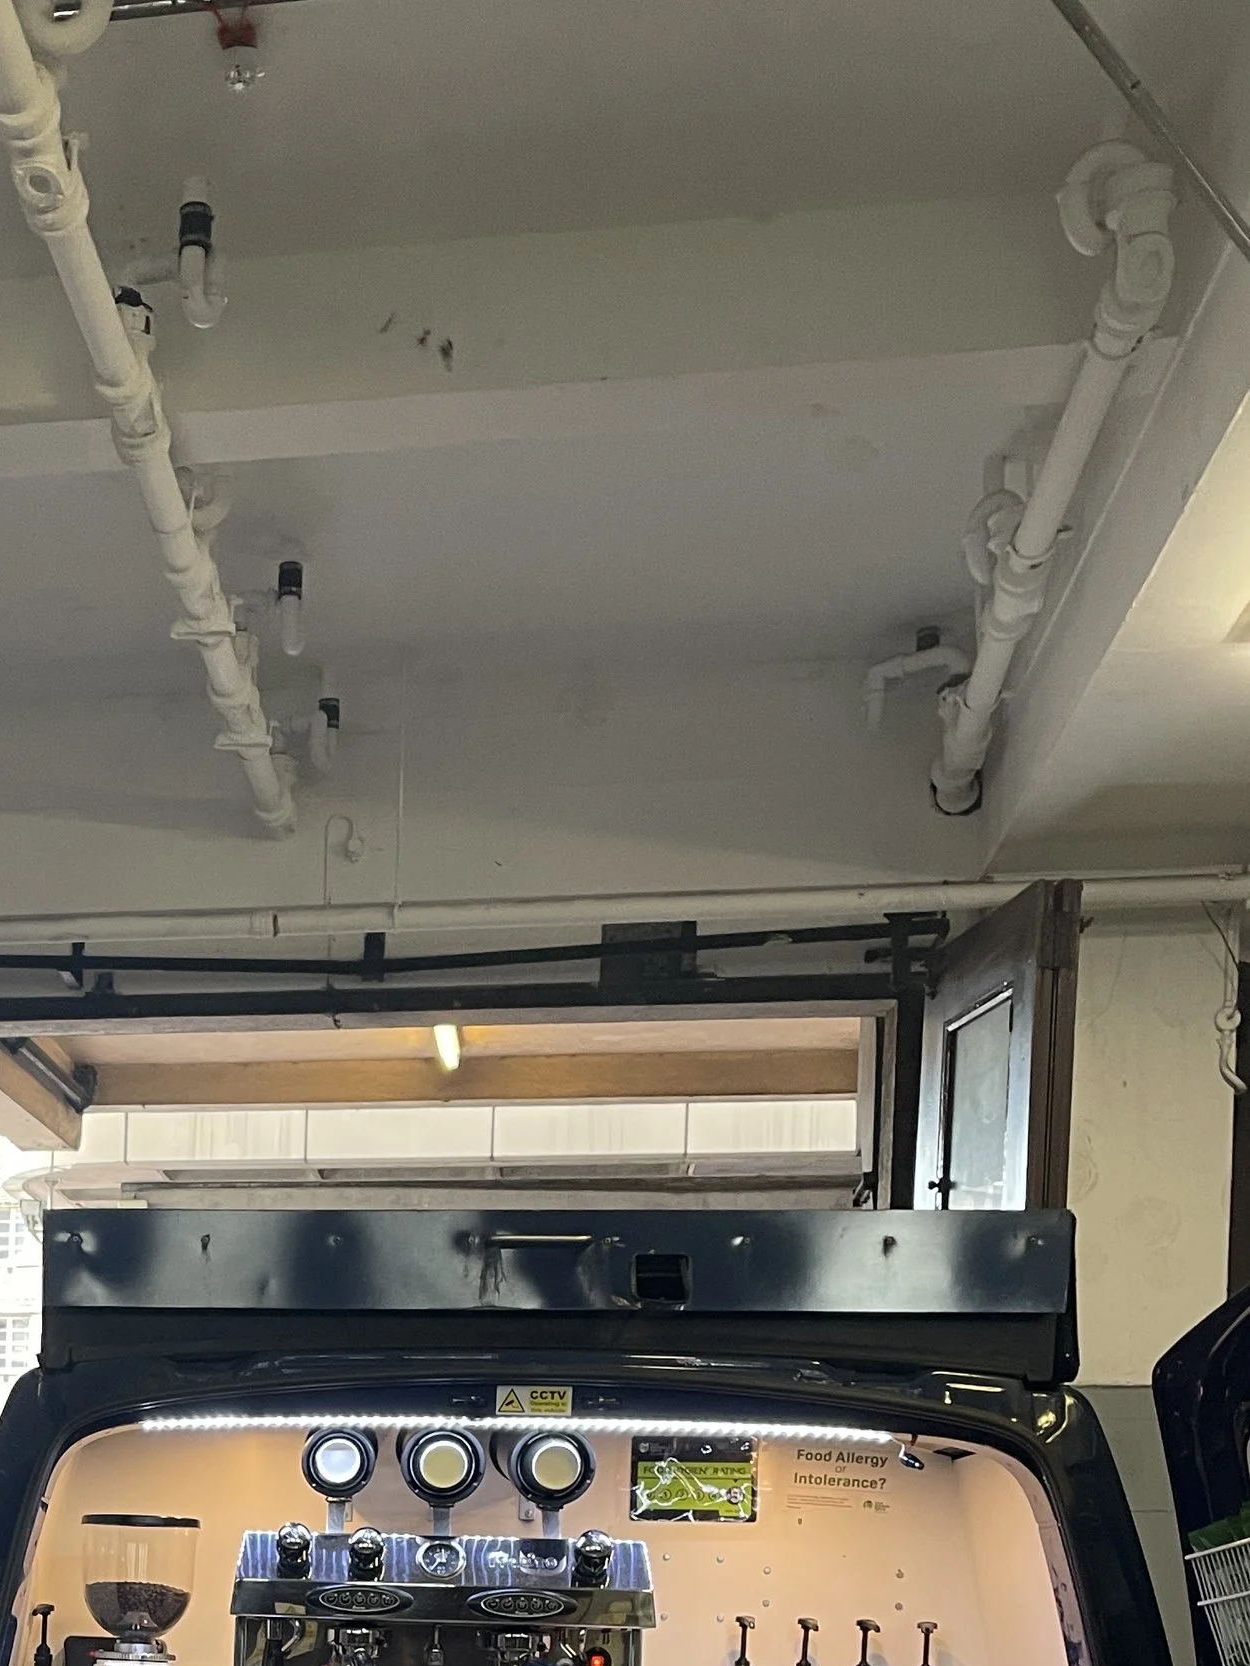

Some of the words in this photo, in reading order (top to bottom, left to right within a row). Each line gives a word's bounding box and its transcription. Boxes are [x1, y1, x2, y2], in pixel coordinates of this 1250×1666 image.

[530, 1390, 566, 1400] CCTV
[796, 1448, 831, 1462] Food
[835, 1450, 889, 1468] Allergy
[835, 1464, 847, 1474] or
[793, 1472, 887, 1490] Intolerance?
